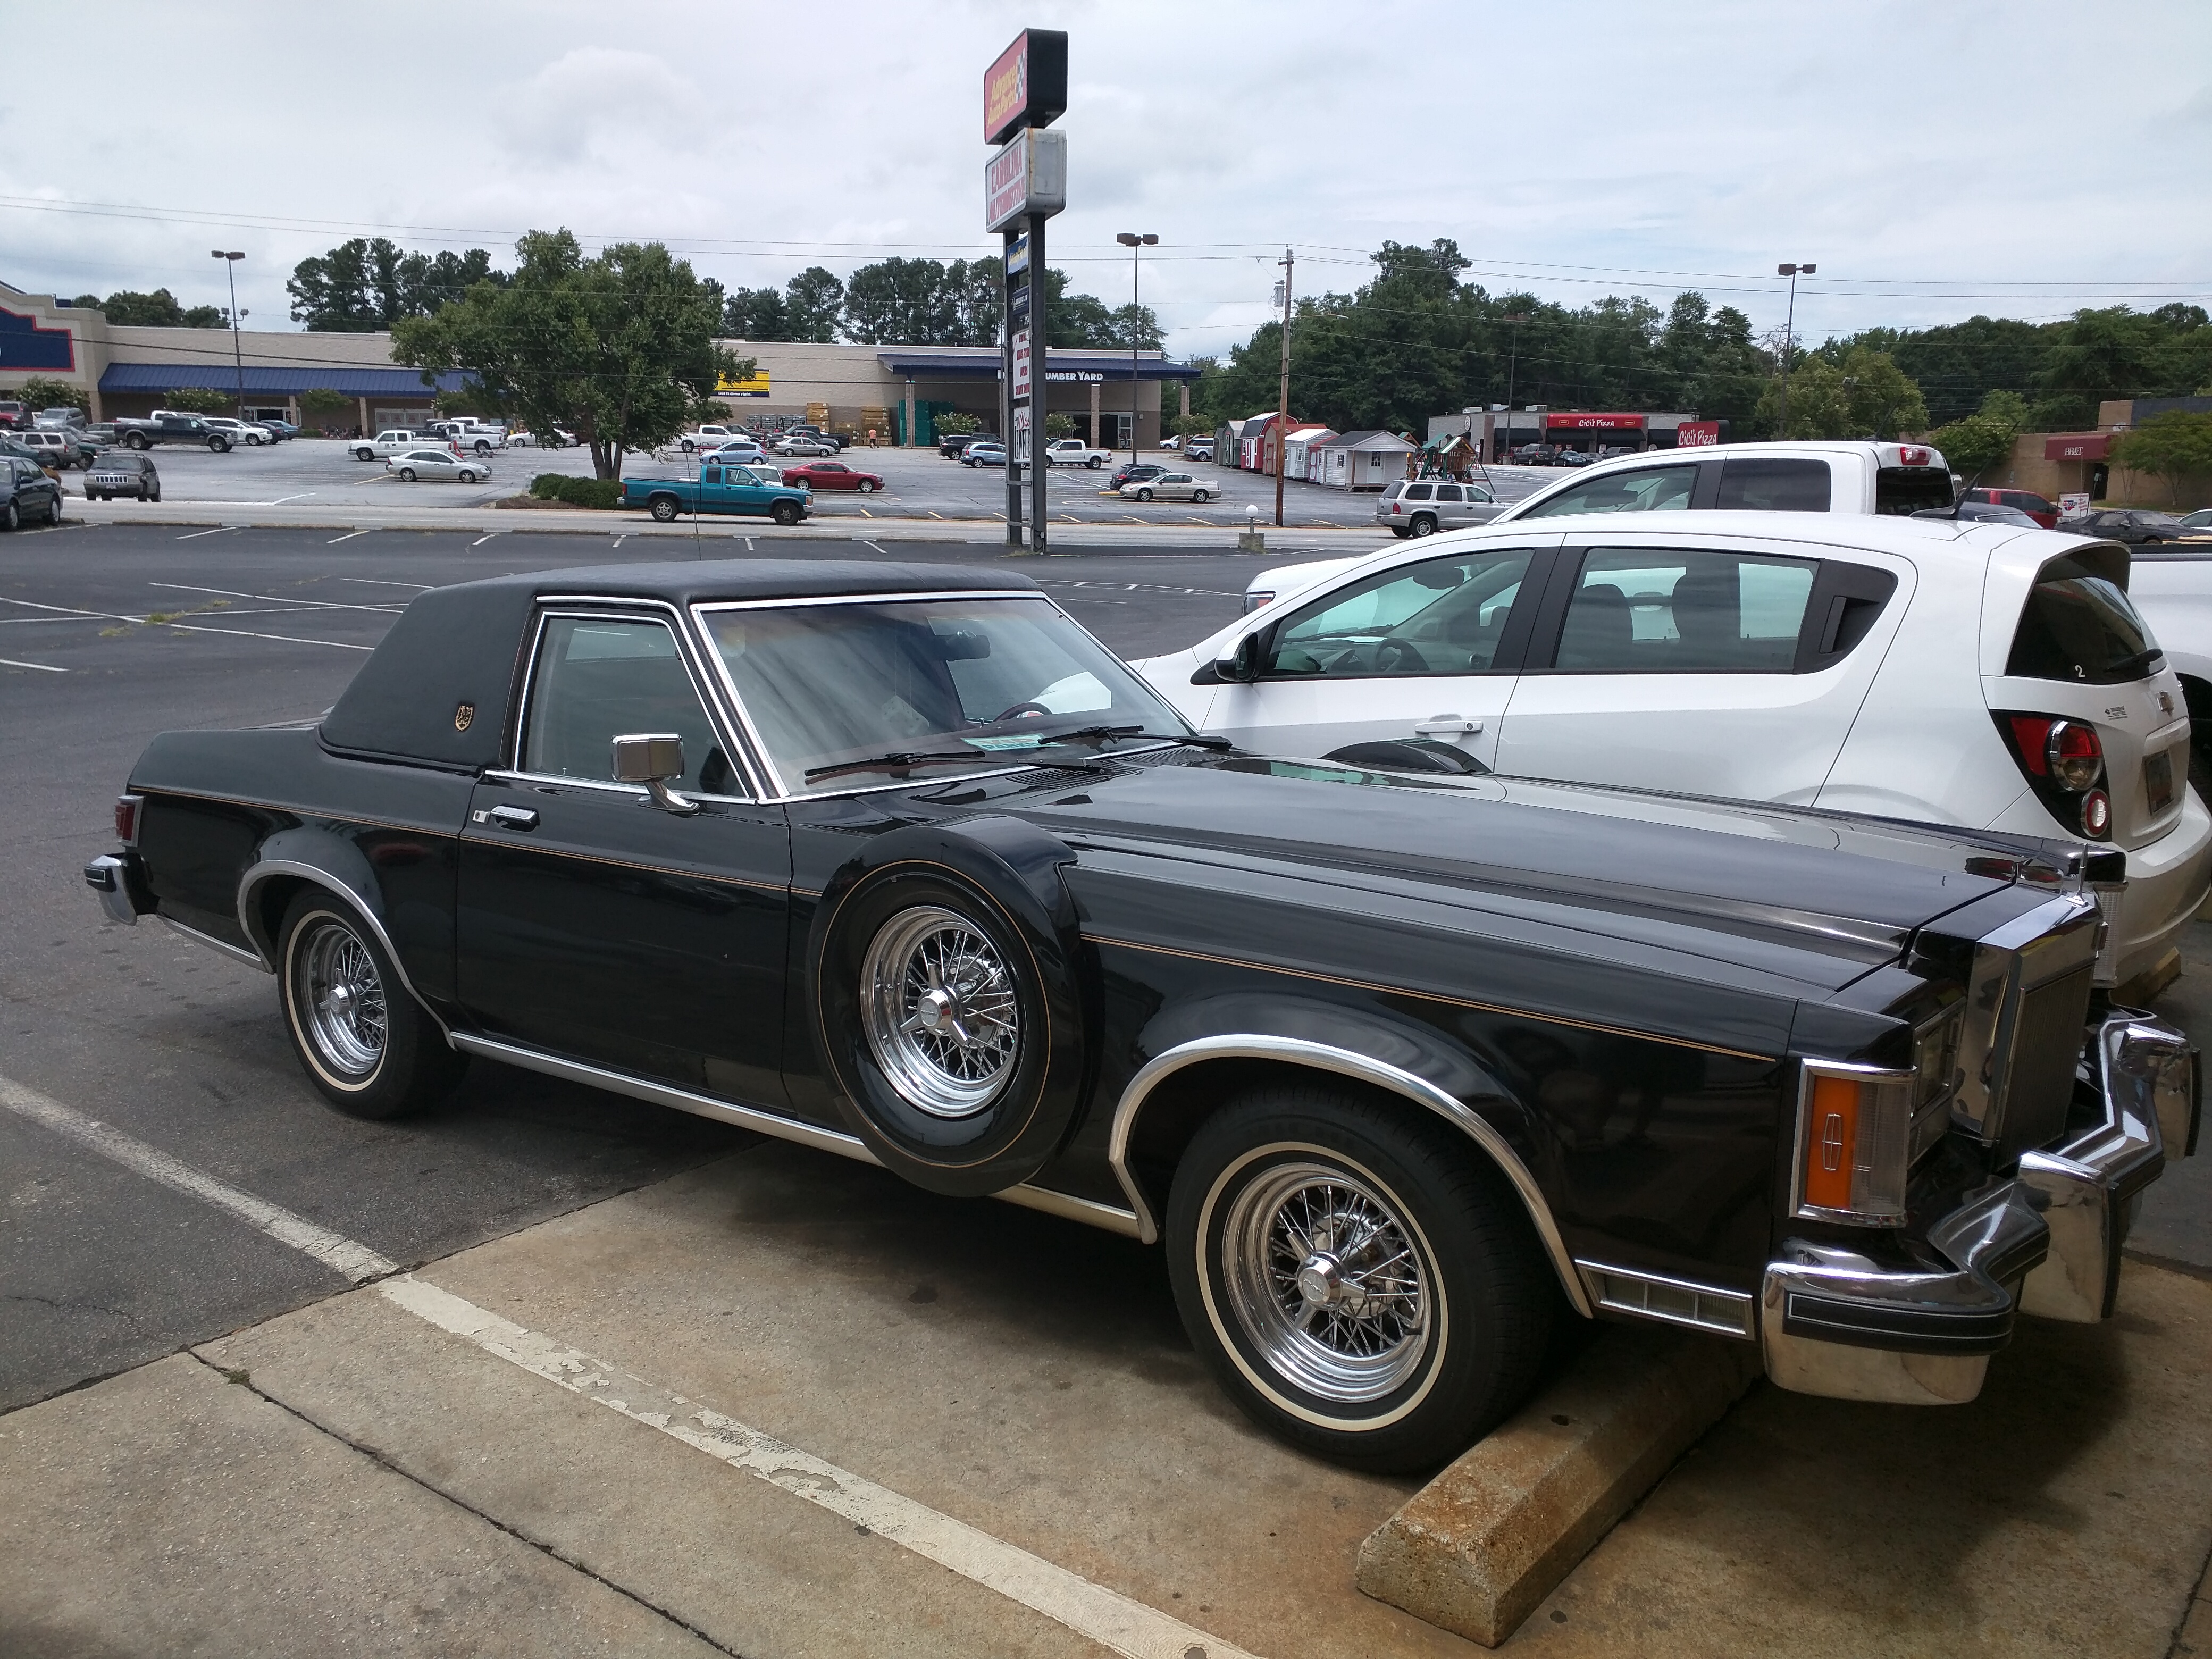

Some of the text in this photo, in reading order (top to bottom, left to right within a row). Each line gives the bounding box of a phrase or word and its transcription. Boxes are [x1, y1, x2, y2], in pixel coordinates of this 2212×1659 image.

[991, 144, 1023, 195] CAROLINA
[1077, 371, 1103, 381] YARD
[1019, 411, 1030, 432] Clas
[1014, 426, 1030, 459] JEWELE
[2065, 447, 2083, 456] BB&T
[2075, 665, 2085, 678] 2
